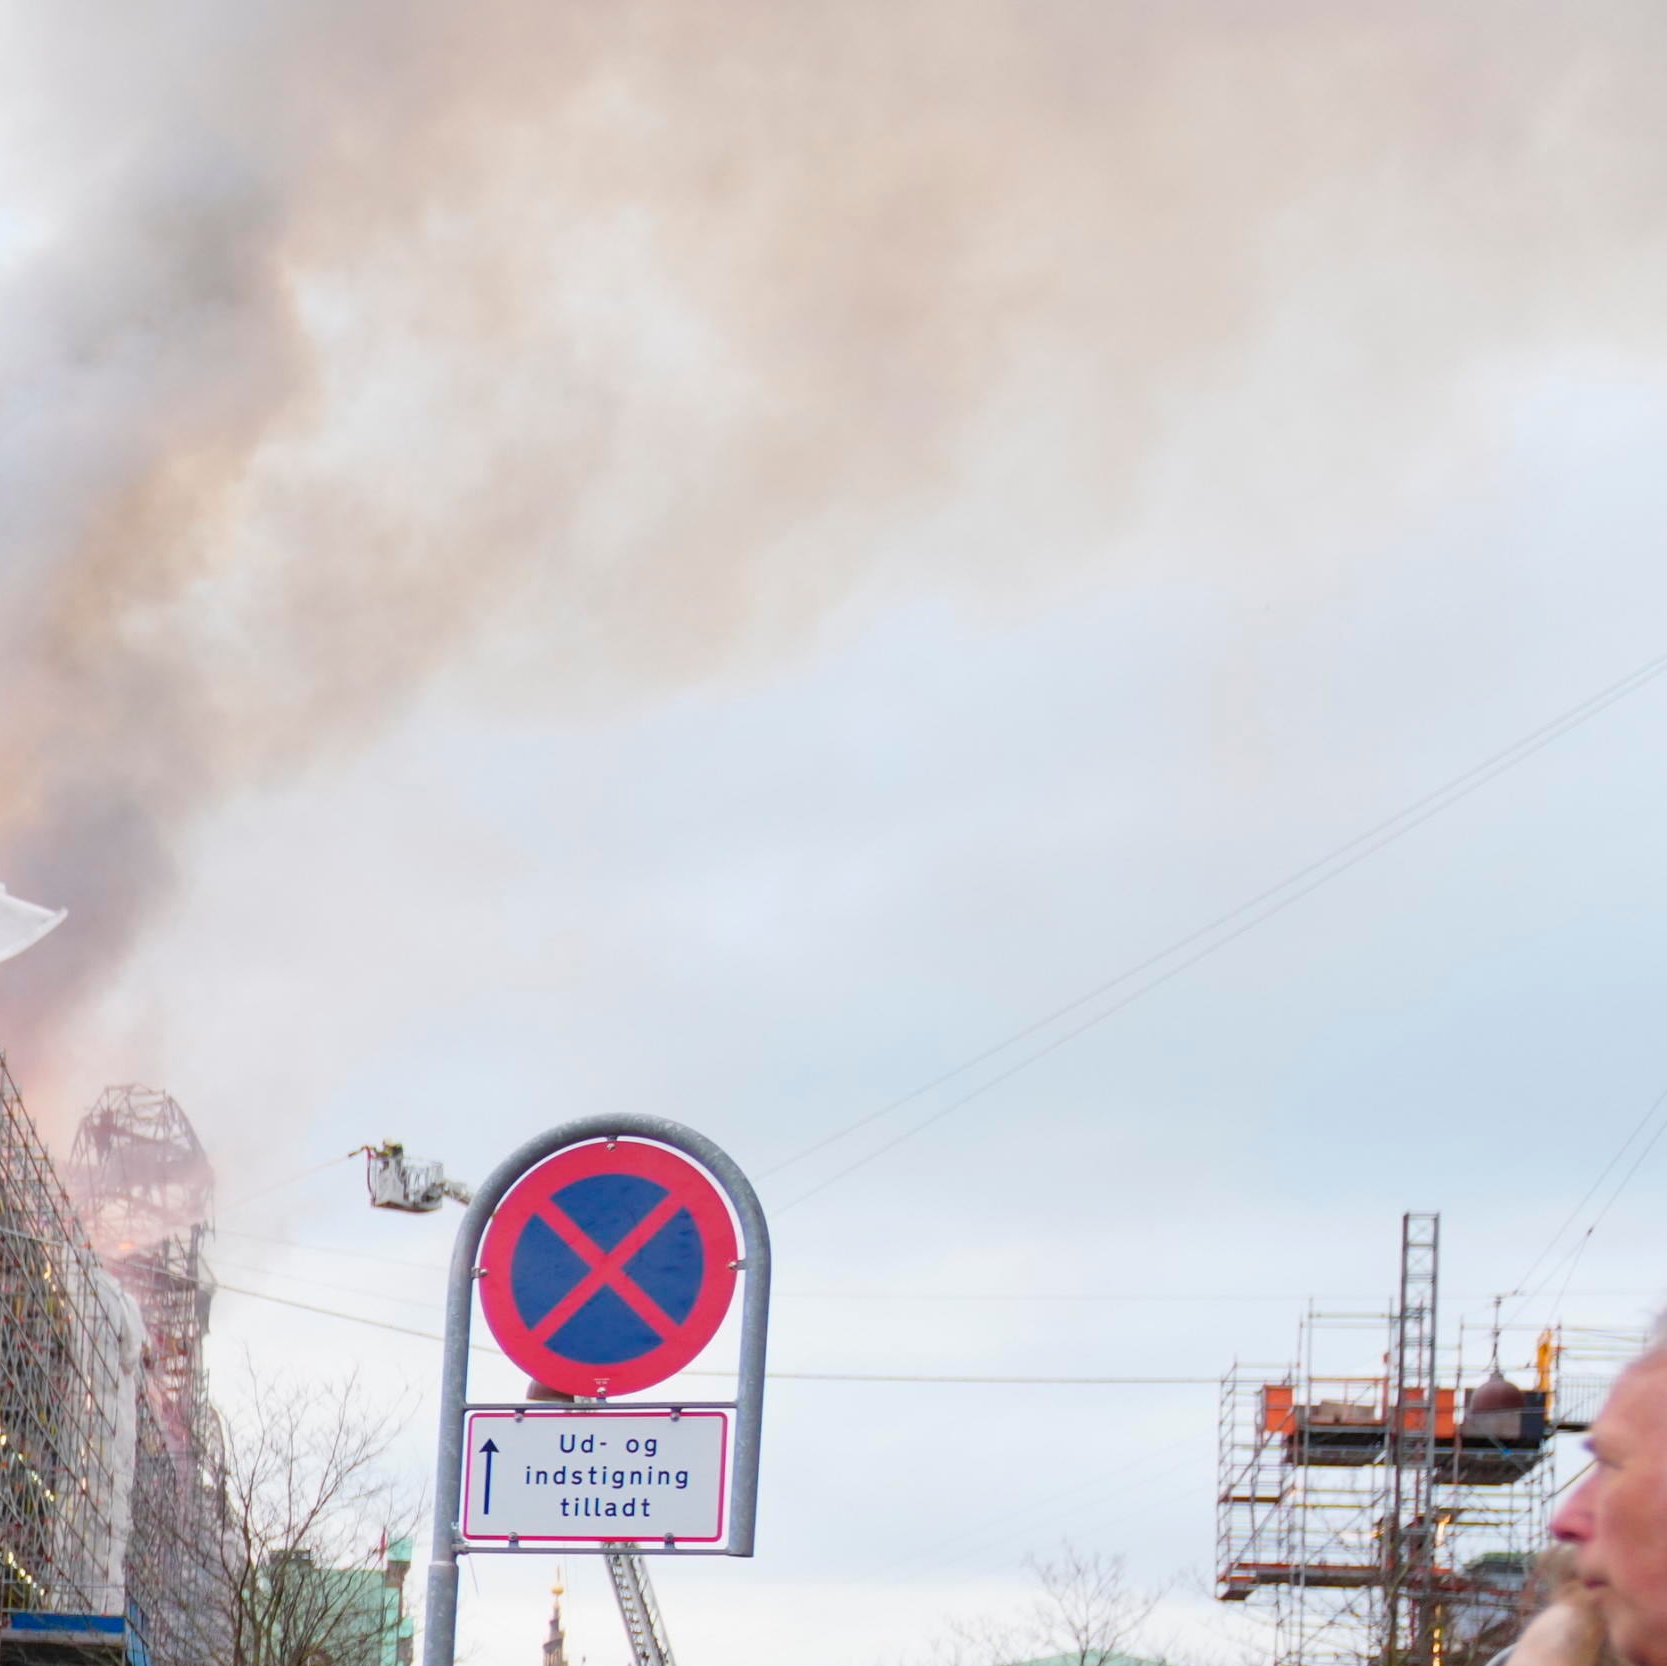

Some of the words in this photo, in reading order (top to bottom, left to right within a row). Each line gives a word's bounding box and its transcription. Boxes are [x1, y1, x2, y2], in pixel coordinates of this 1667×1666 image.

[558, 1433, 608, 1454] Ud-
[625, 1437, 659, 1458] og
[525, 1465, 690, 1489] indstigning
[559, 1497, 652, 1518] tilladt
